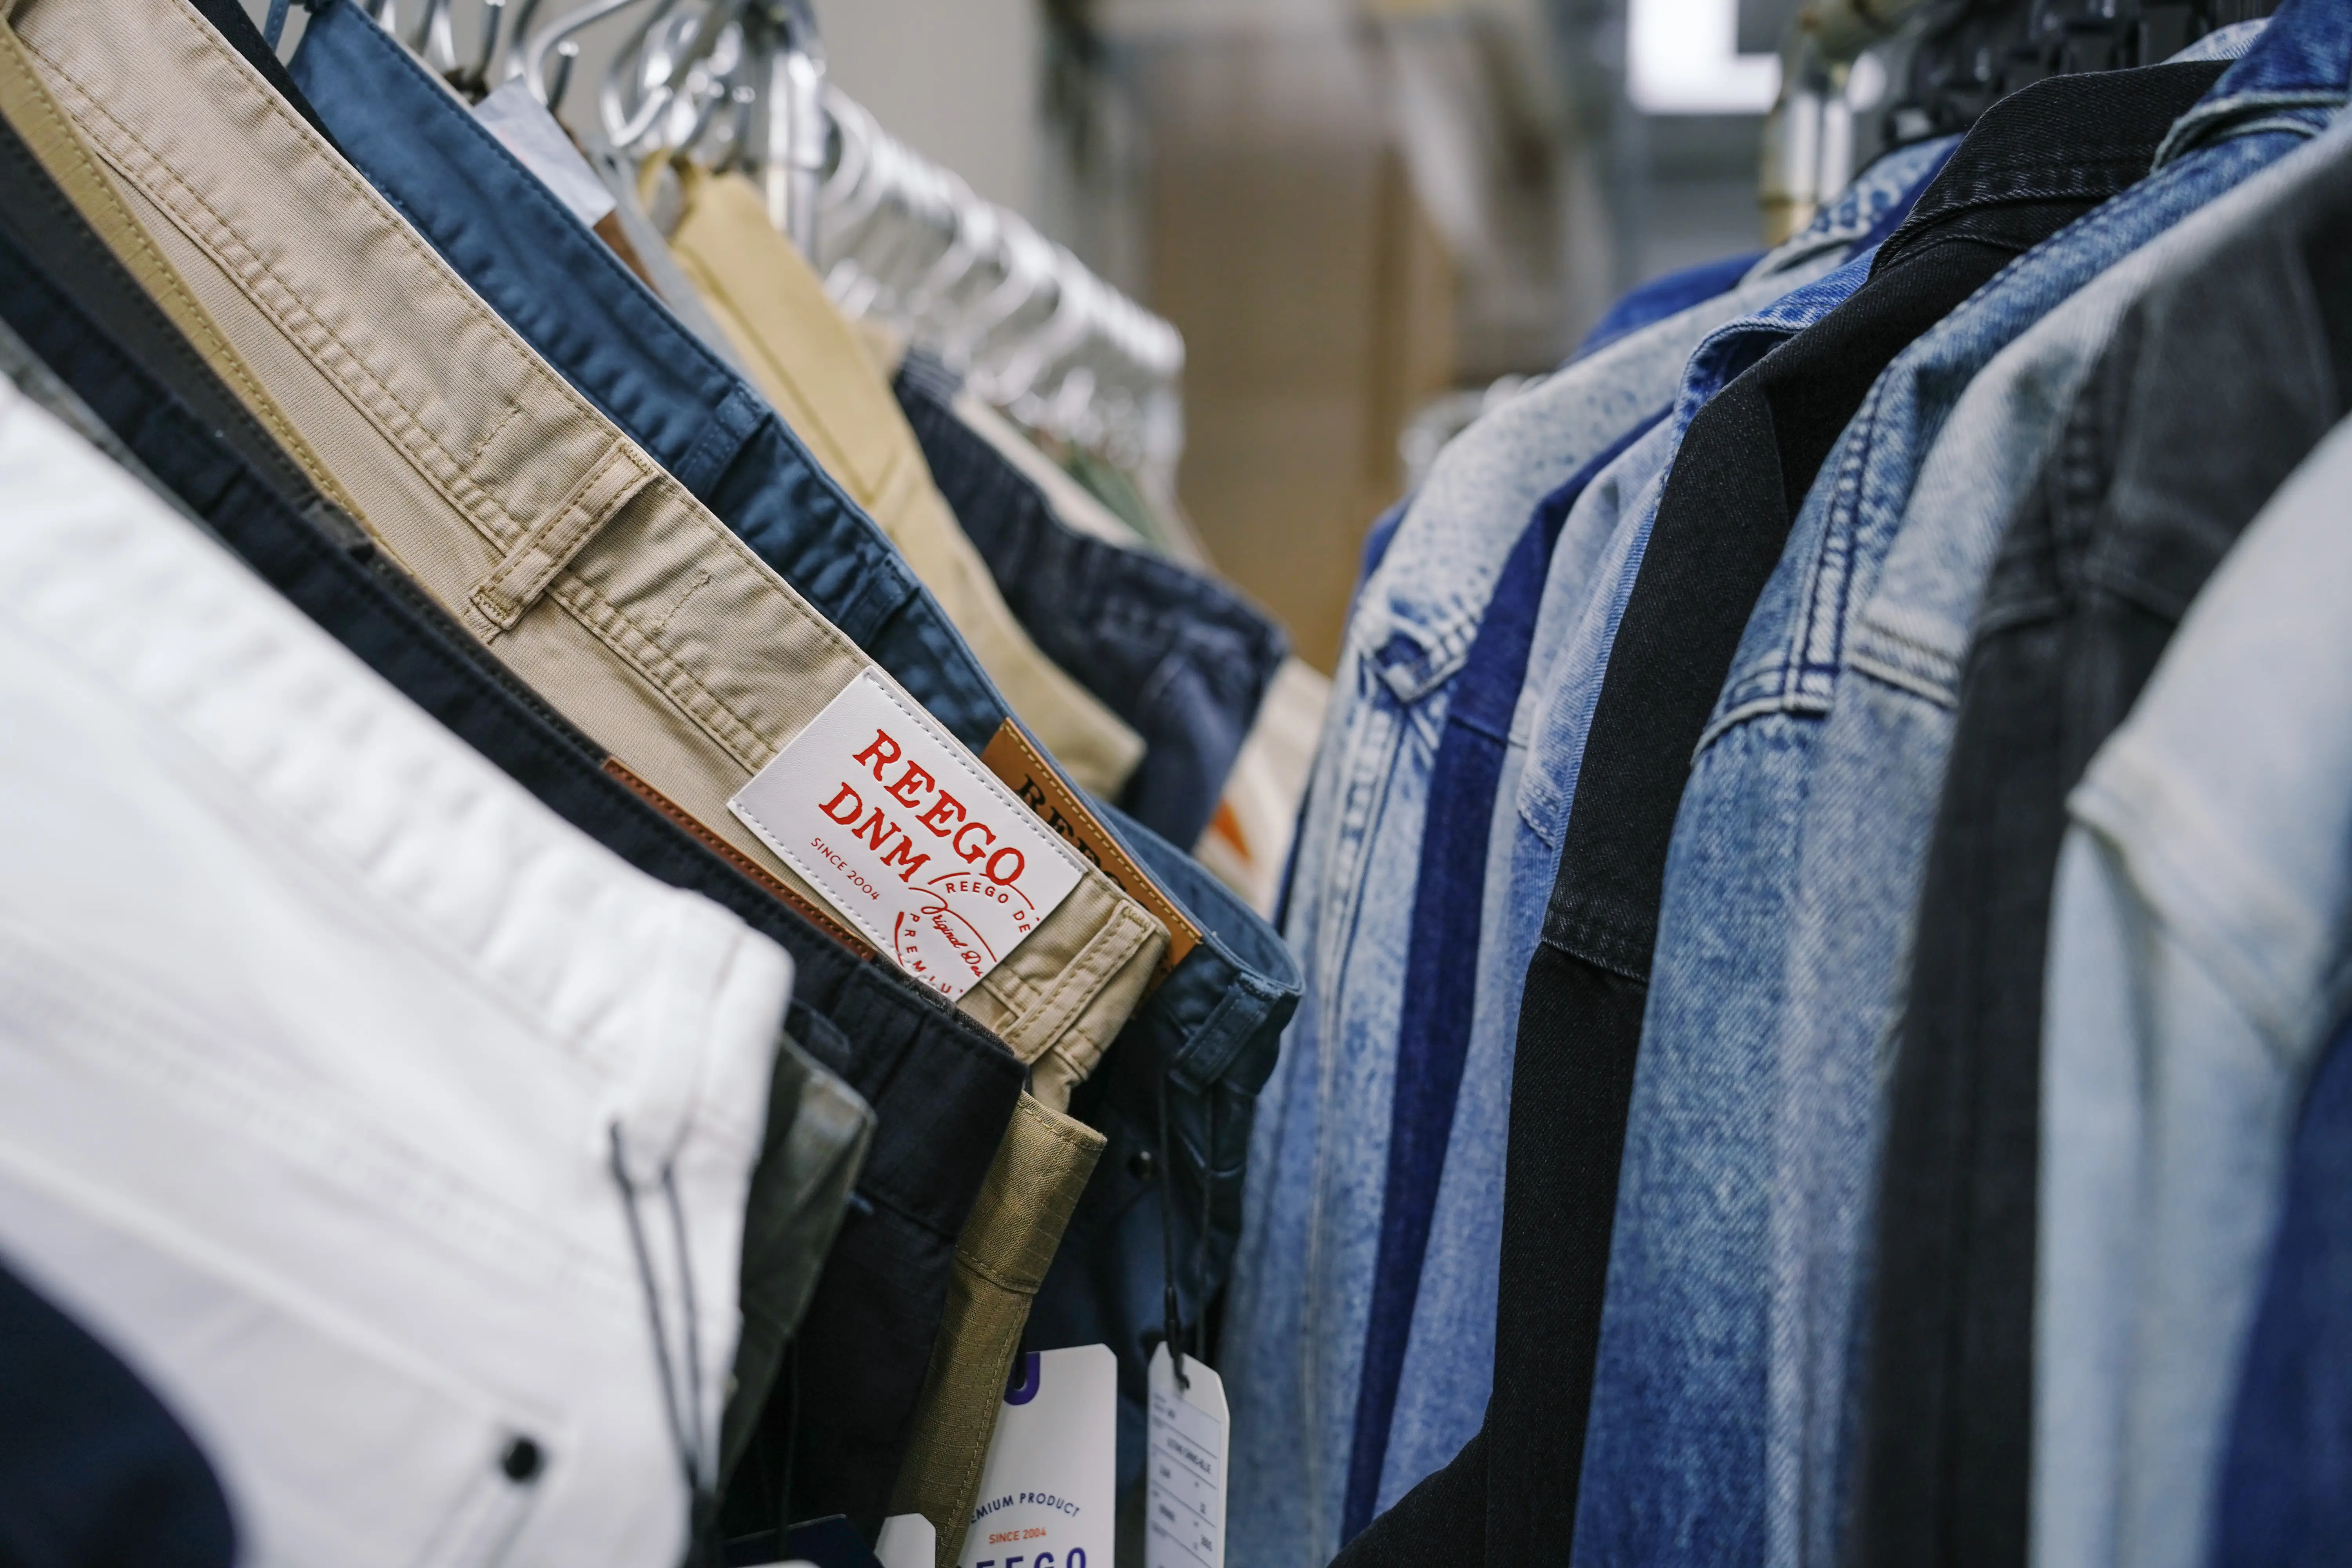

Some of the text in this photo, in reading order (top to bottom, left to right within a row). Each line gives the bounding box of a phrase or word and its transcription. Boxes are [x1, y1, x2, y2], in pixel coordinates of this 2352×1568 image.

[818, 782, 931, 883] DNM
[852, 729, 1025, 887] REEGO
[811, 837, 880, 900] SINCE 2004
[946, 881, 1009, 904] REEGO
[904, 913, 964, 995] PREMIU
[988, 1527, 1047, 1545] SINCE 2004
[1019, 1492, 1080, 1517] PRODUCT
